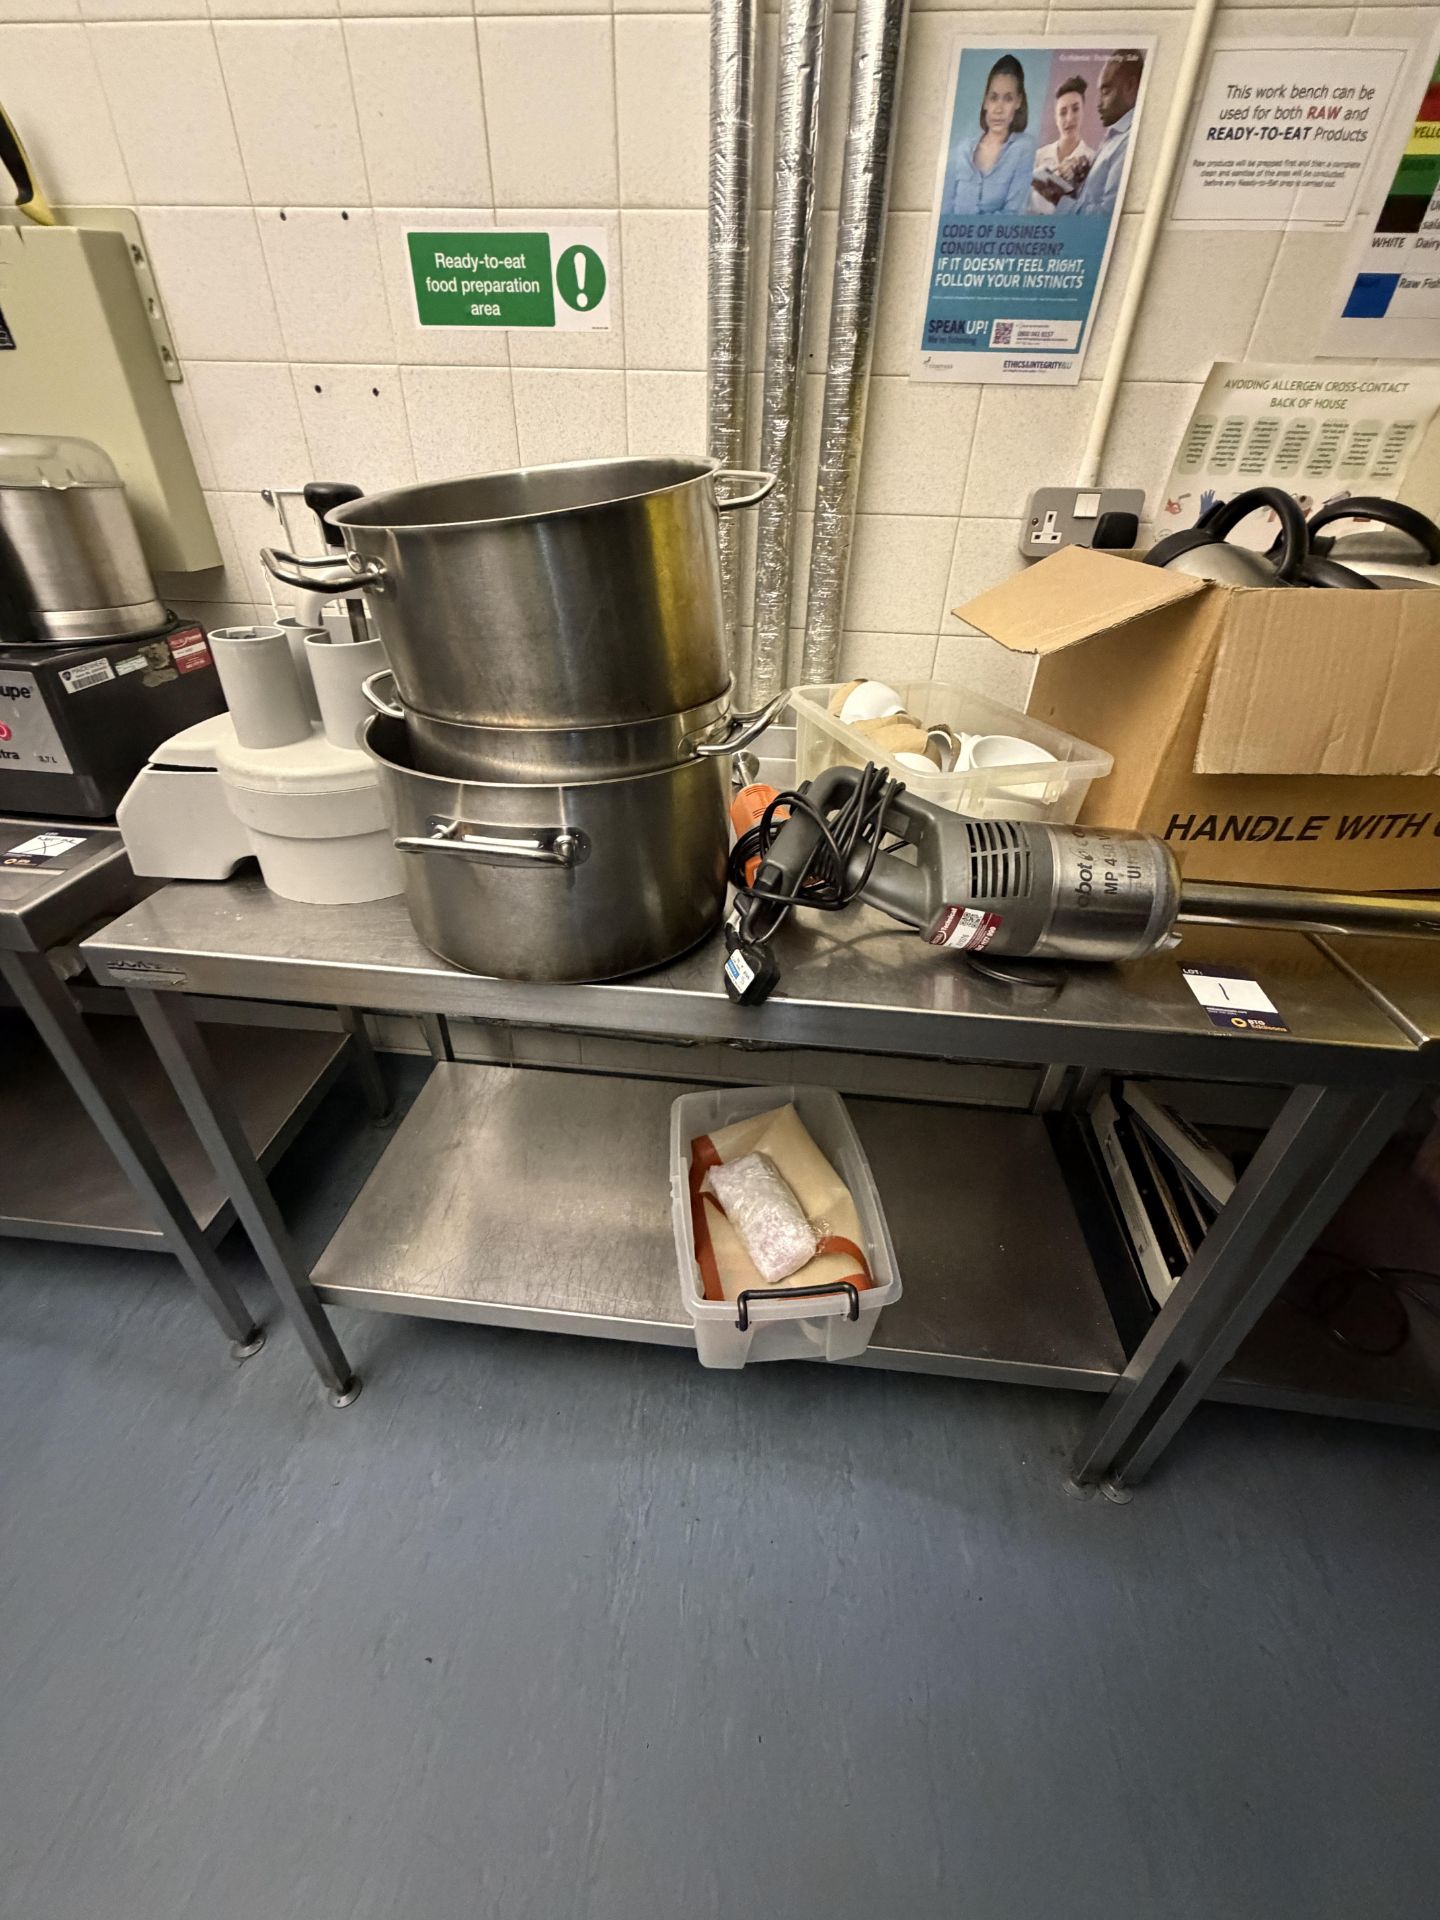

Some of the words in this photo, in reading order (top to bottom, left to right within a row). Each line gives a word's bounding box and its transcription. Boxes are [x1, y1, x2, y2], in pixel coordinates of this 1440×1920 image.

[1227, 84, 1252, 99] This
[1255, 85, 1287, 99] work
[1290, 84, 1329, 99] bench
[1332, 87, 1356, 100] can
[1358, 85, 1375, 100] be
[1219, 105, 1249, 120] used
[1252, 105, 1271, 120] for
[1274, 105, 1303, 120] both
[1306, 106, 1342, 120] RAW
[1343, 107, 1369, 121] and
[1206, 127, 1312, 141] READY-TO-EAT
[1314, 127, 1368, 142] Products
[942, 224, 975, 238] CODE
[977, 225, 994, 238] OF
[995, 225, 1055, 239] BUSINESS
[940, 241, 996, 255] CONDUCT
[998, 242, 1064, 256] CONCERN?
[1371, 237, 1405, 249] WHITE
[434, 252, 527, 272] Ready-to-eat
[937, 257, 949, 270] IF
[949, 257, 961, 270] IT
[963, 258, 1015, 271] DOESN'T
[1018, 259, 1044, 272] FEEL
[1046, 259, 1086, 274] RIGHT,
[425, 276, 457, 292] food
[461, 277, 540, 296] preparation
[935, 273, 985, 287] FOLLOW
[987, 274, 1020, 288] YOUR
[1023, 275, 1084, 289] INSTINCTS
[1398, 278, 1420, 289] Raw
[470, 303, 501, 316] area
[1224, 378, 1270, 390] AVOIDING
[1272, 380, 1323, 392] ALLERGEN
[1325, 381, 1410, 393] CROSS-CONTACT
[1269, 397, 1296, 408] BACK
[1297, 398, 1312, 408] OF
[1314, 398, 1348, 410] HOUSE
[1164, 813, 1329, 841] HANDLE
[1335, 812, 1432, 841] WITH
[1103, 871, 1119, 895] MP
